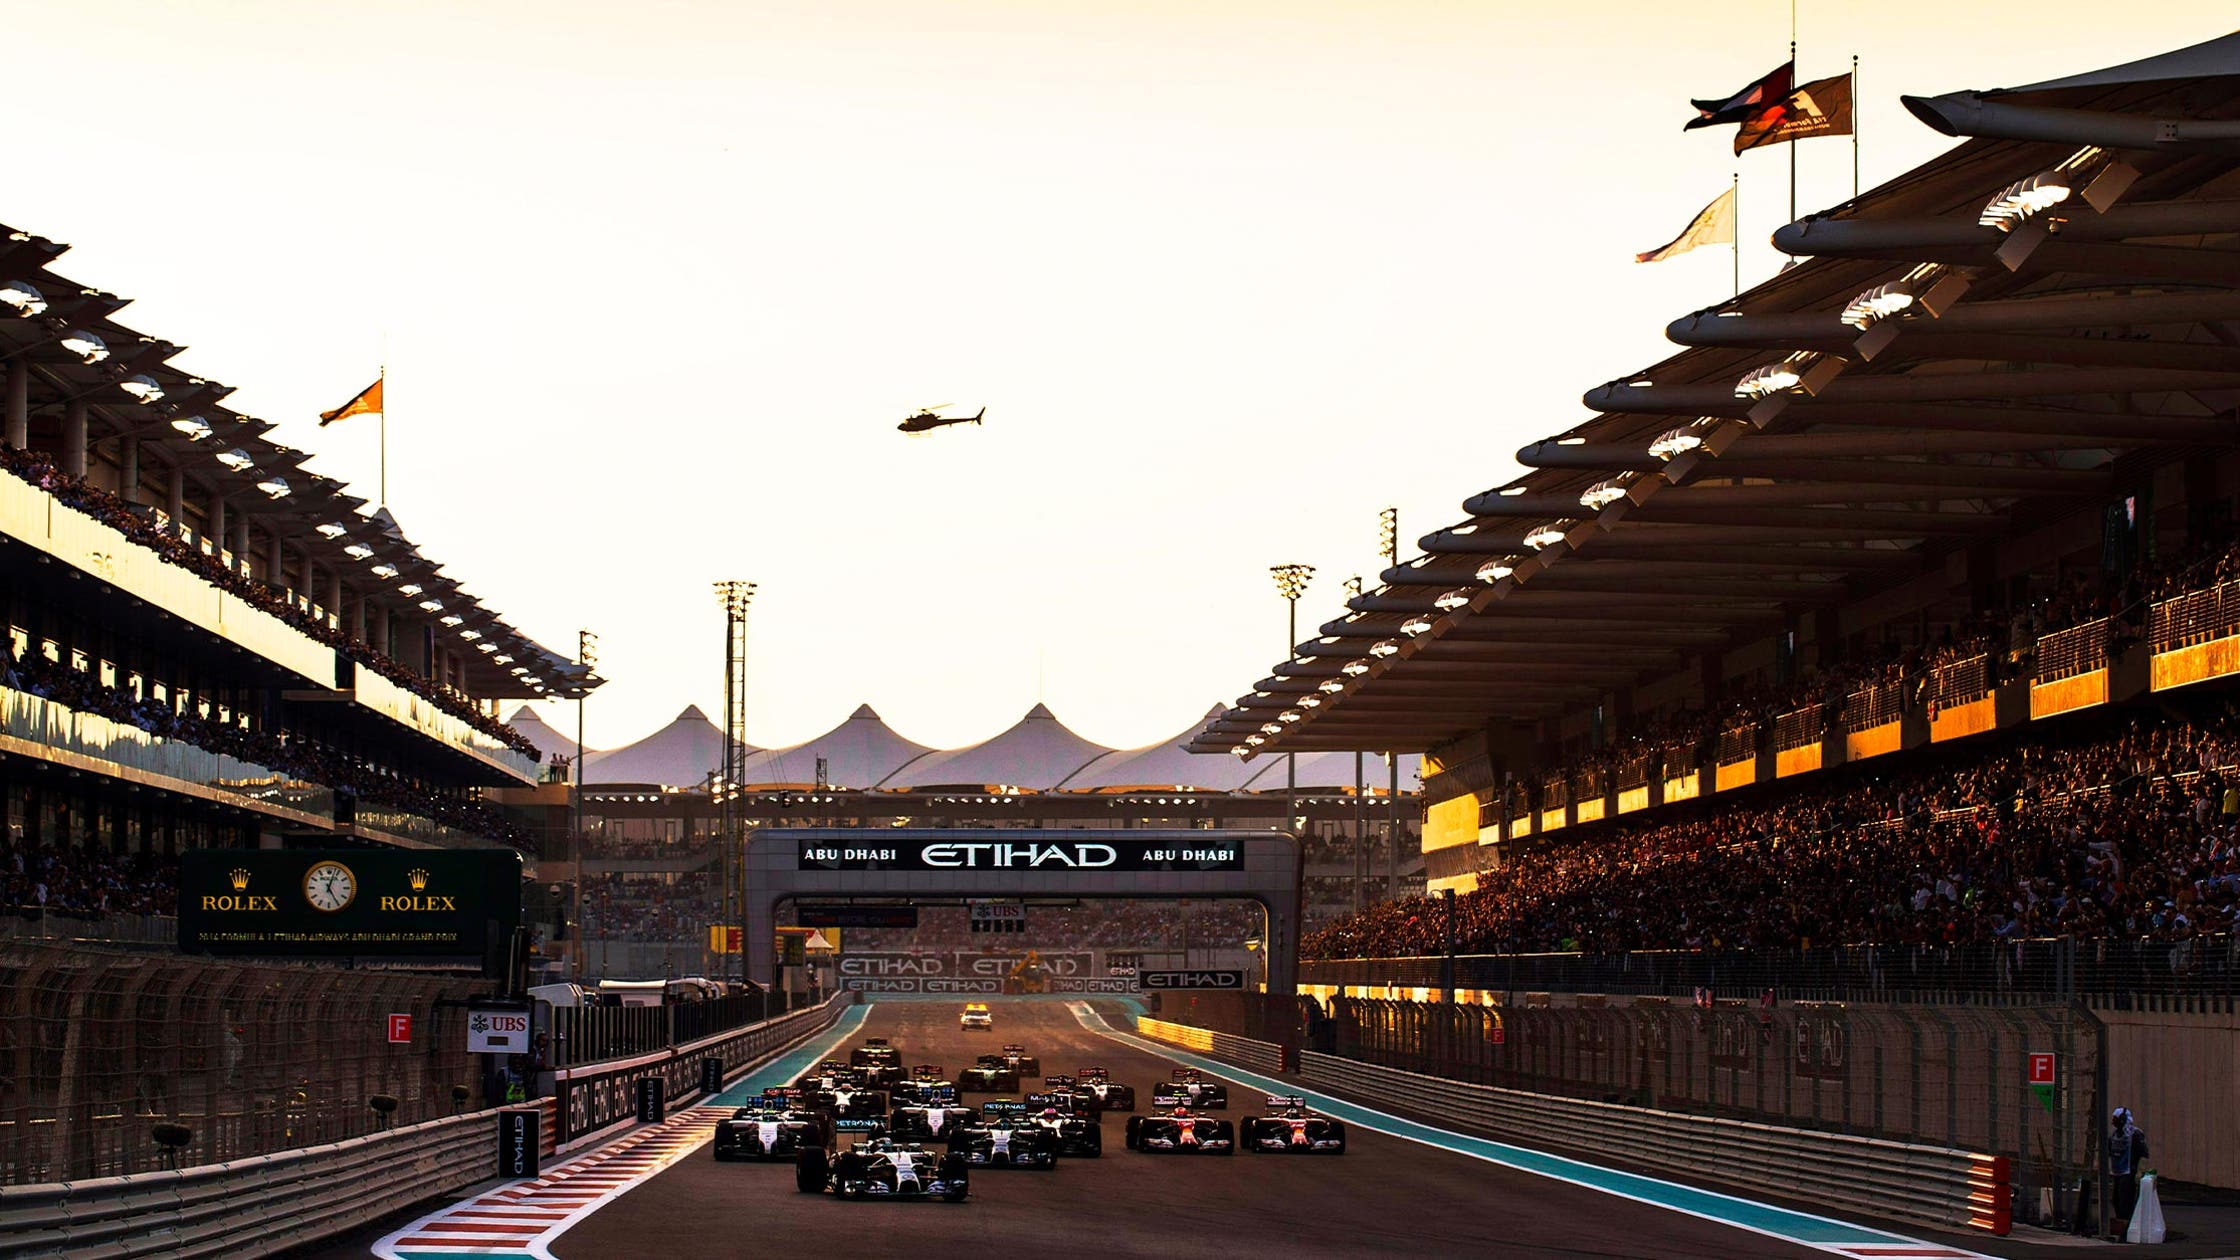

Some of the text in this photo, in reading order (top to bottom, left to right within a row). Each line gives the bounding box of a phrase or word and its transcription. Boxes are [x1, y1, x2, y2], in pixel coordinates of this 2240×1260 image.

[804, 849, 897, 860] ABU DHABI
[921, 843, 1117, 867] ETIHAD
[1142, 850, 1235, 861] ABU DHABI
[201, 896, 278, 911] ROLEX
[380, 896, 456, 911] ROLEX
[992, 905, 1019, 917] UBS
[840, 958, 943, 974] ETIHAD
[848, 980, 915, 991] ETIHAD
[927, 980, 998, 992] ETIHAD
[1089, 980, 1125, 991] ETIHAD
[1147, 973, 1237, 987] ETIHAD
[395, 1018, 407, 1038] F
[491, 1017, 526, 1032] UBS
[2035, 1057, 2048, 1079] F
[646, 1080, 654, 1120] ETIHAD
[513, 1115, 525, 1175] ETIHAD
